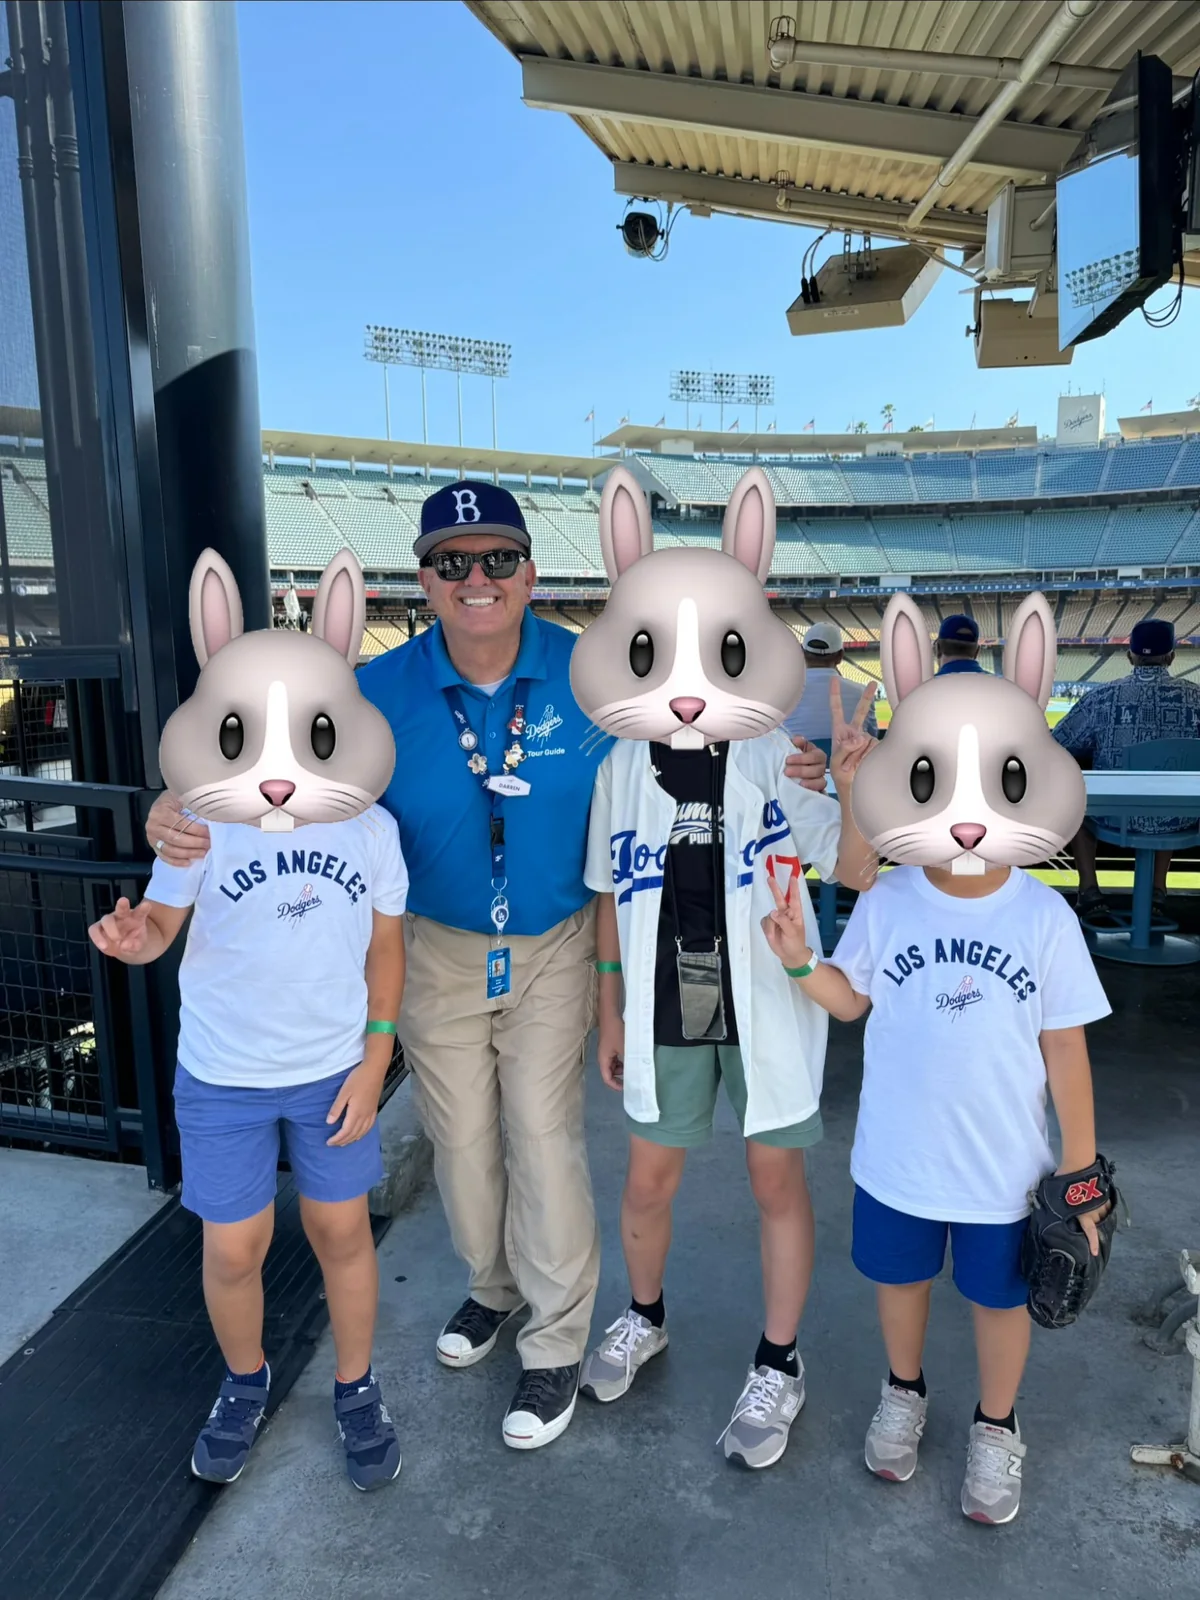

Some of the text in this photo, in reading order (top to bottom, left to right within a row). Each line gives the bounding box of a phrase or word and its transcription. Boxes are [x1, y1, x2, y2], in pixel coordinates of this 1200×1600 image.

[1063, 412, 1094, 430] Dodgers
[451, 489, 481, 524] B
[525, 714, 564, 740] Dodgers
[544, 747, 565, 756] Guide
[498, 782, 521, 792] DARREN
[219, 849, 367, 903] LOS ANGELES
[277, 894, 323, 919] Dodgers
[882, 938, 1037, 1001] LOS ANGELES
[935, 988, 984, 1011] Dodgers
